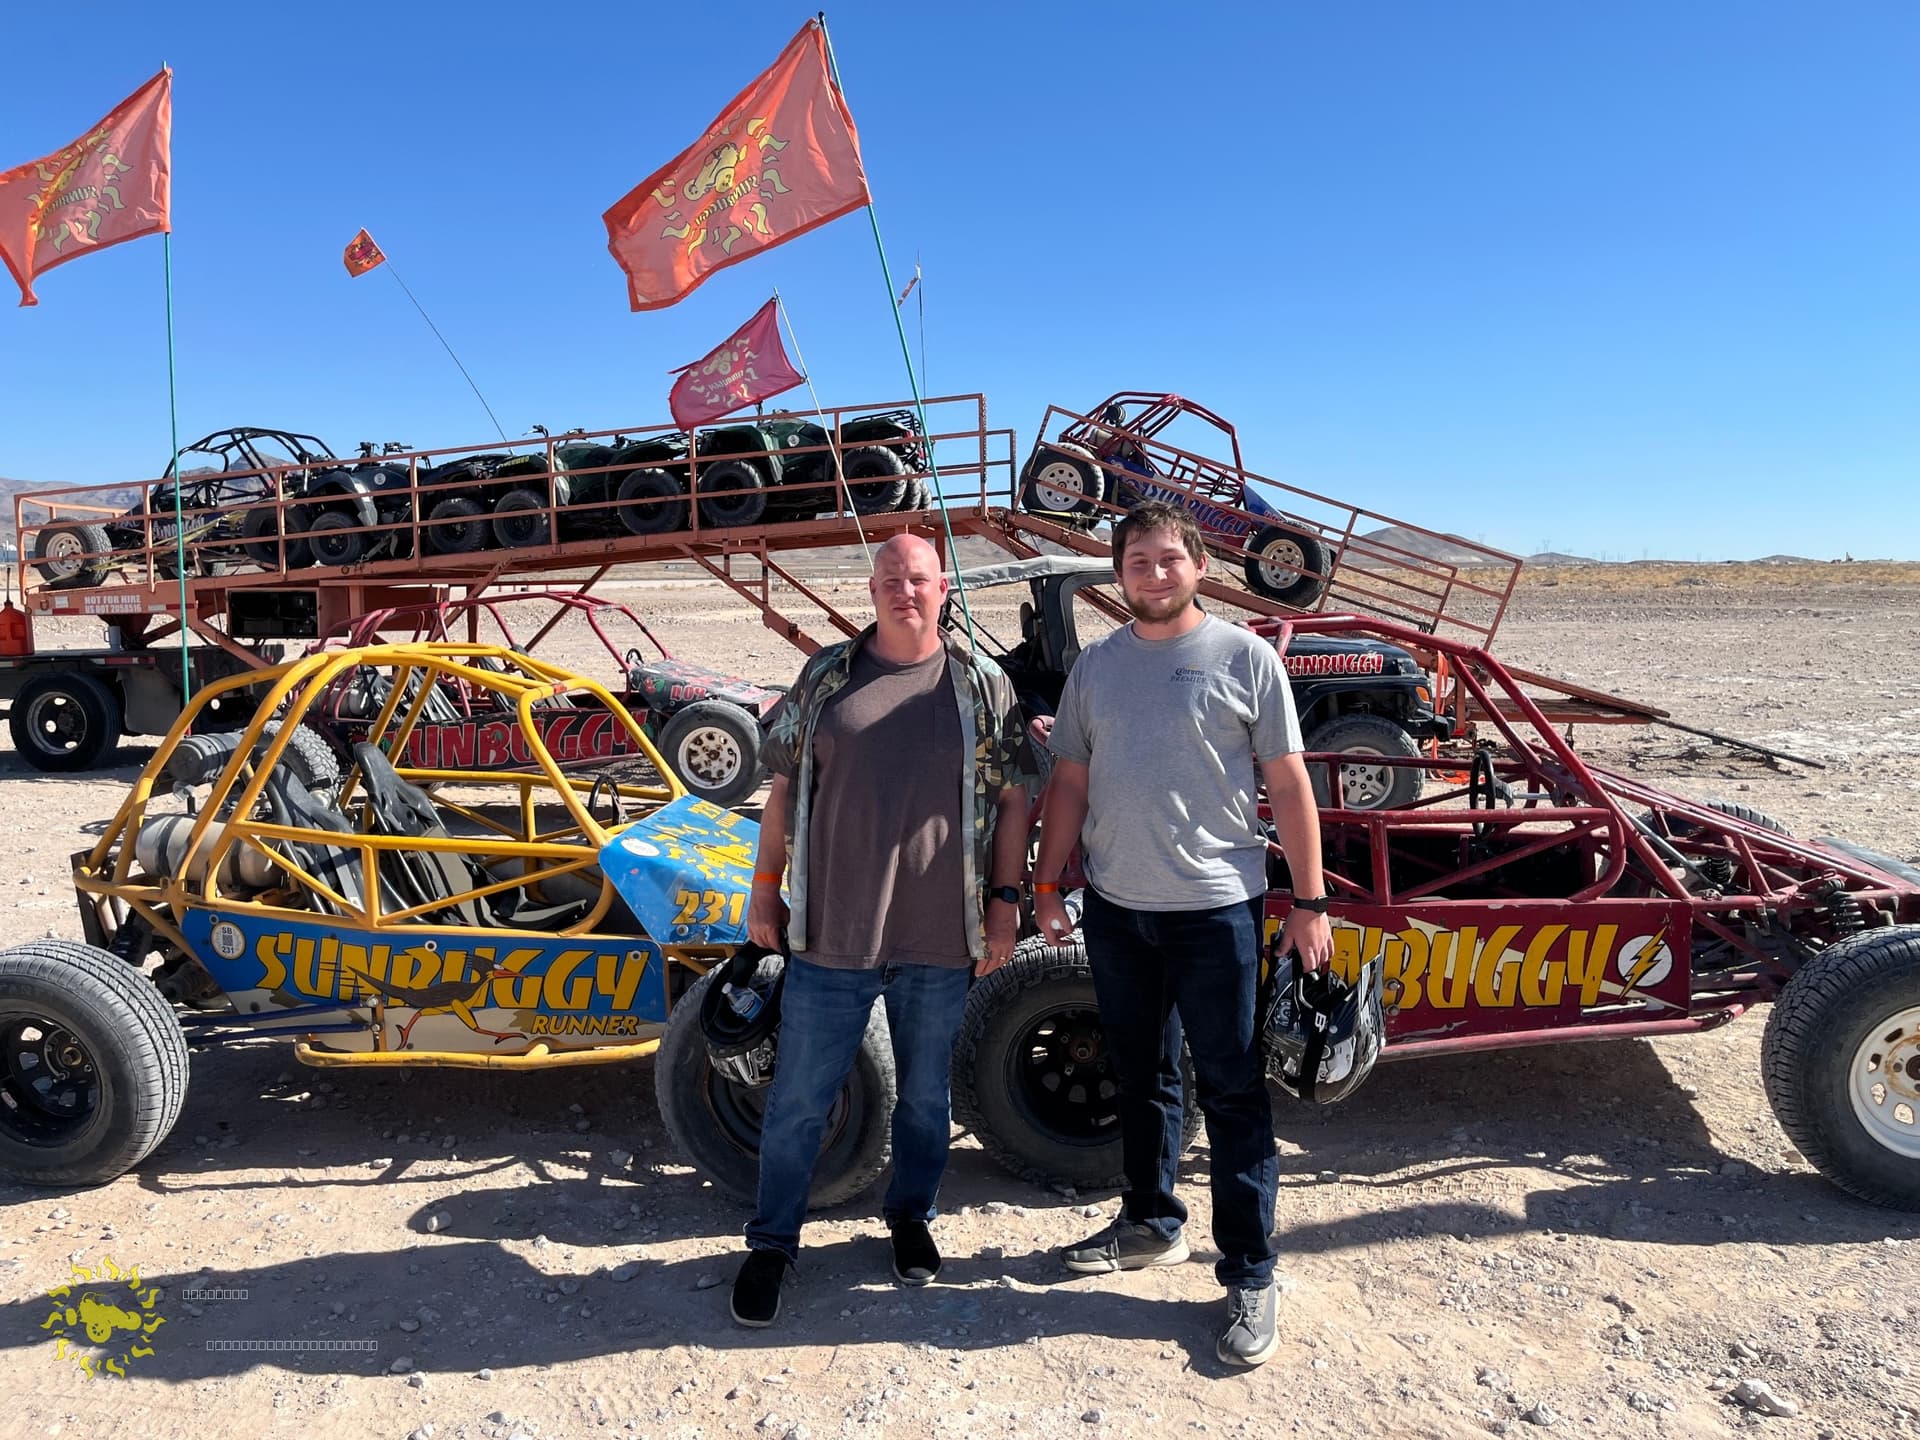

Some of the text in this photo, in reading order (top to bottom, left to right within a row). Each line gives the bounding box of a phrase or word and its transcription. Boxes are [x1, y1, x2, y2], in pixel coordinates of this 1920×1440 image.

[84, 595, 141, 604] NOT FOR HIRE
[96, 605, 109, 614] DOT
[1175, 667, 1205, 676] Corona
[671, 889, 747, 926] 231
[222, 926, 233, 935] SB
[221, 945, 234, 954] 231
[530, 1014, 640, 1036] RUNNER
